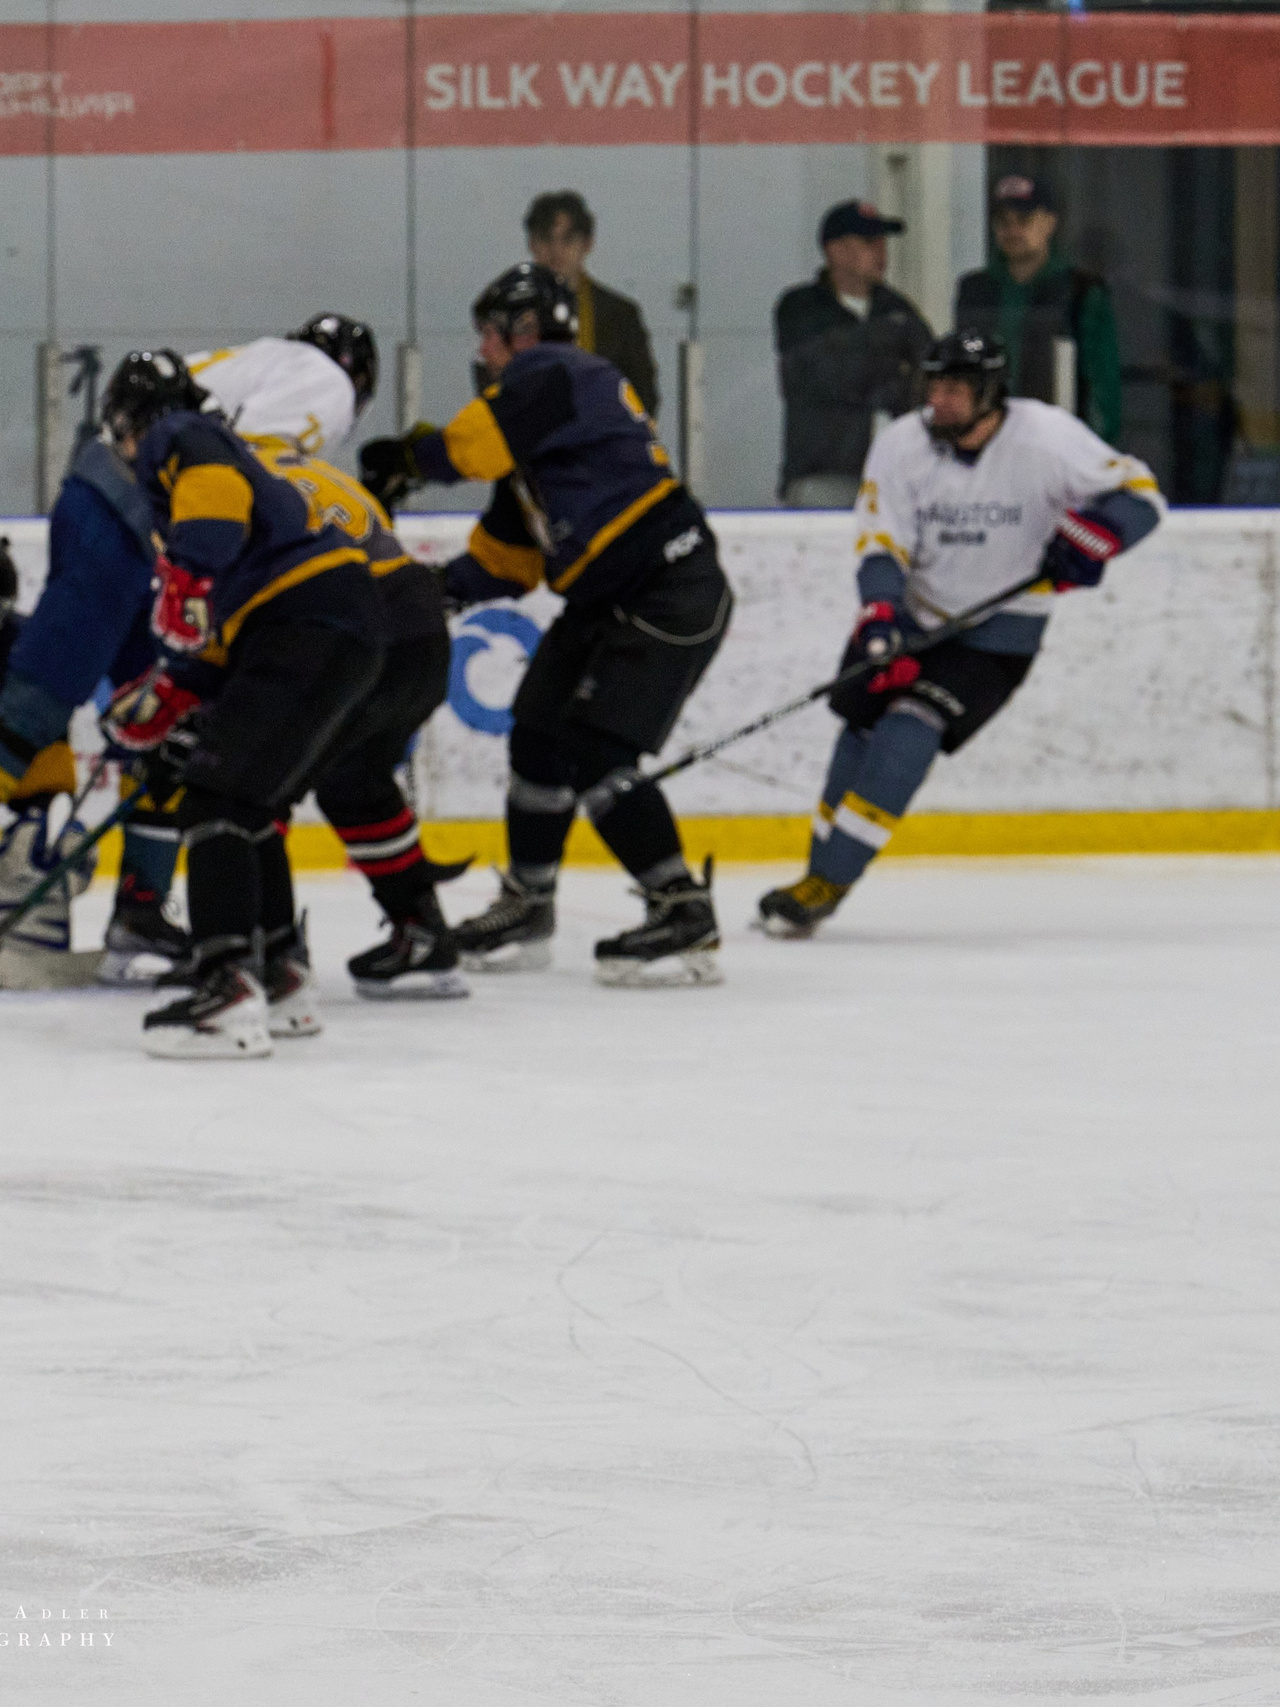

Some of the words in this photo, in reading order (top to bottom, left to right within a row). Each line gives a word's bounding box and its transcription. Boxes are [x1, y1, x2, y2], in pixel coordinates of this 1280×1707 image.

[425, 63, 542, 110] SILK
[558, 62, 687, 108] WAY
[703, 62, 940, 108] HOCKEY
[957, 61, 1187, 108] LEAGUE
